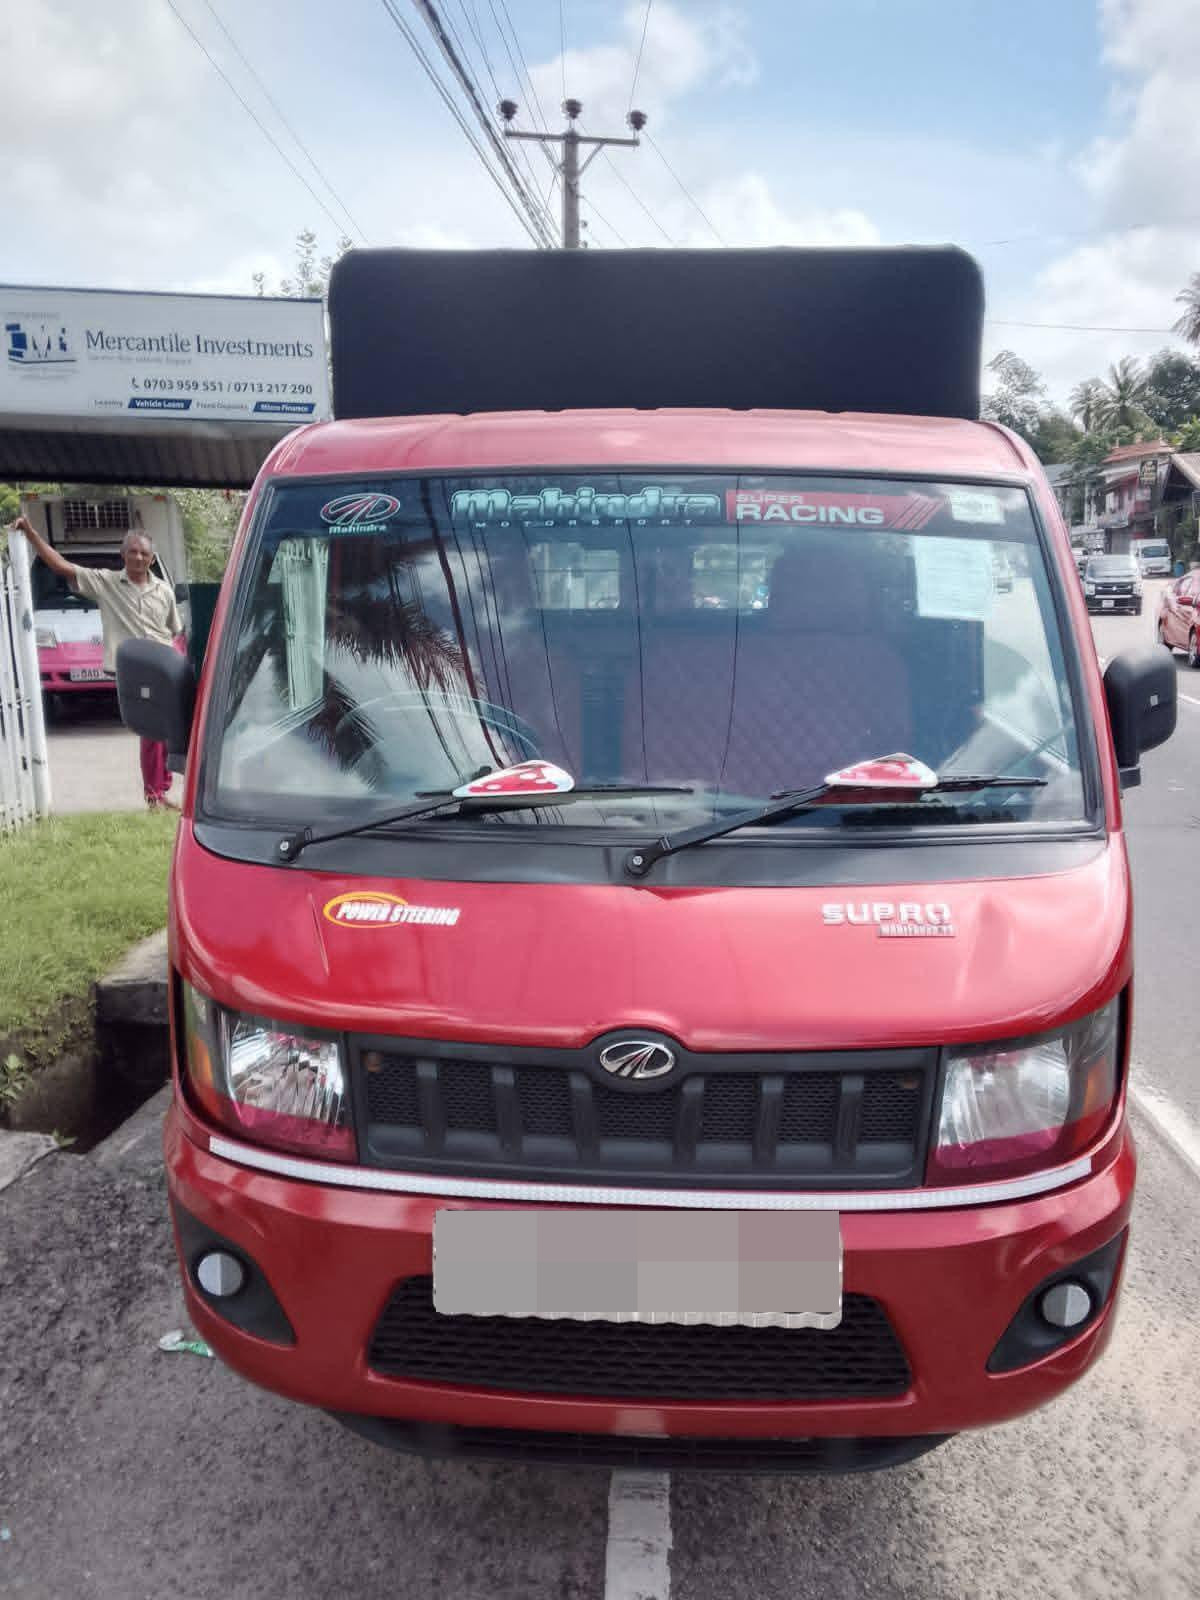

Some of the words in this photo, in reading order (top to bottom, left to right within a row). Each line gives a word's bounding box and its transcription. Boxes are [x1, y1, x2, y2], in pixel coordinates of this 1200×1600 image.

[85, 329, 191, 354] Mercantile
[196, 333, 313, 359] Investments
[144, 379, 173, 391] 0703
[177, 380, 199, 392] 959
[202, 381, 223, 392] 551
[234, 382, 264, 393] 0713
[267, 383, 288, 394] 217
[291, 384, 313, 395] 290
[135, 400, 162, 408] Vehicle
[451, 487, 720, 520] Mahindra
[736, 494, 804, 504] SUPER
[736, 504, 884, 524] RACING
[329, 523, 387, 535] Mahindra
[336, 902, 392, 922] POWER
[390, 904, 461, 926] STEERING
[821, 903, 952, 925] SUPRO
